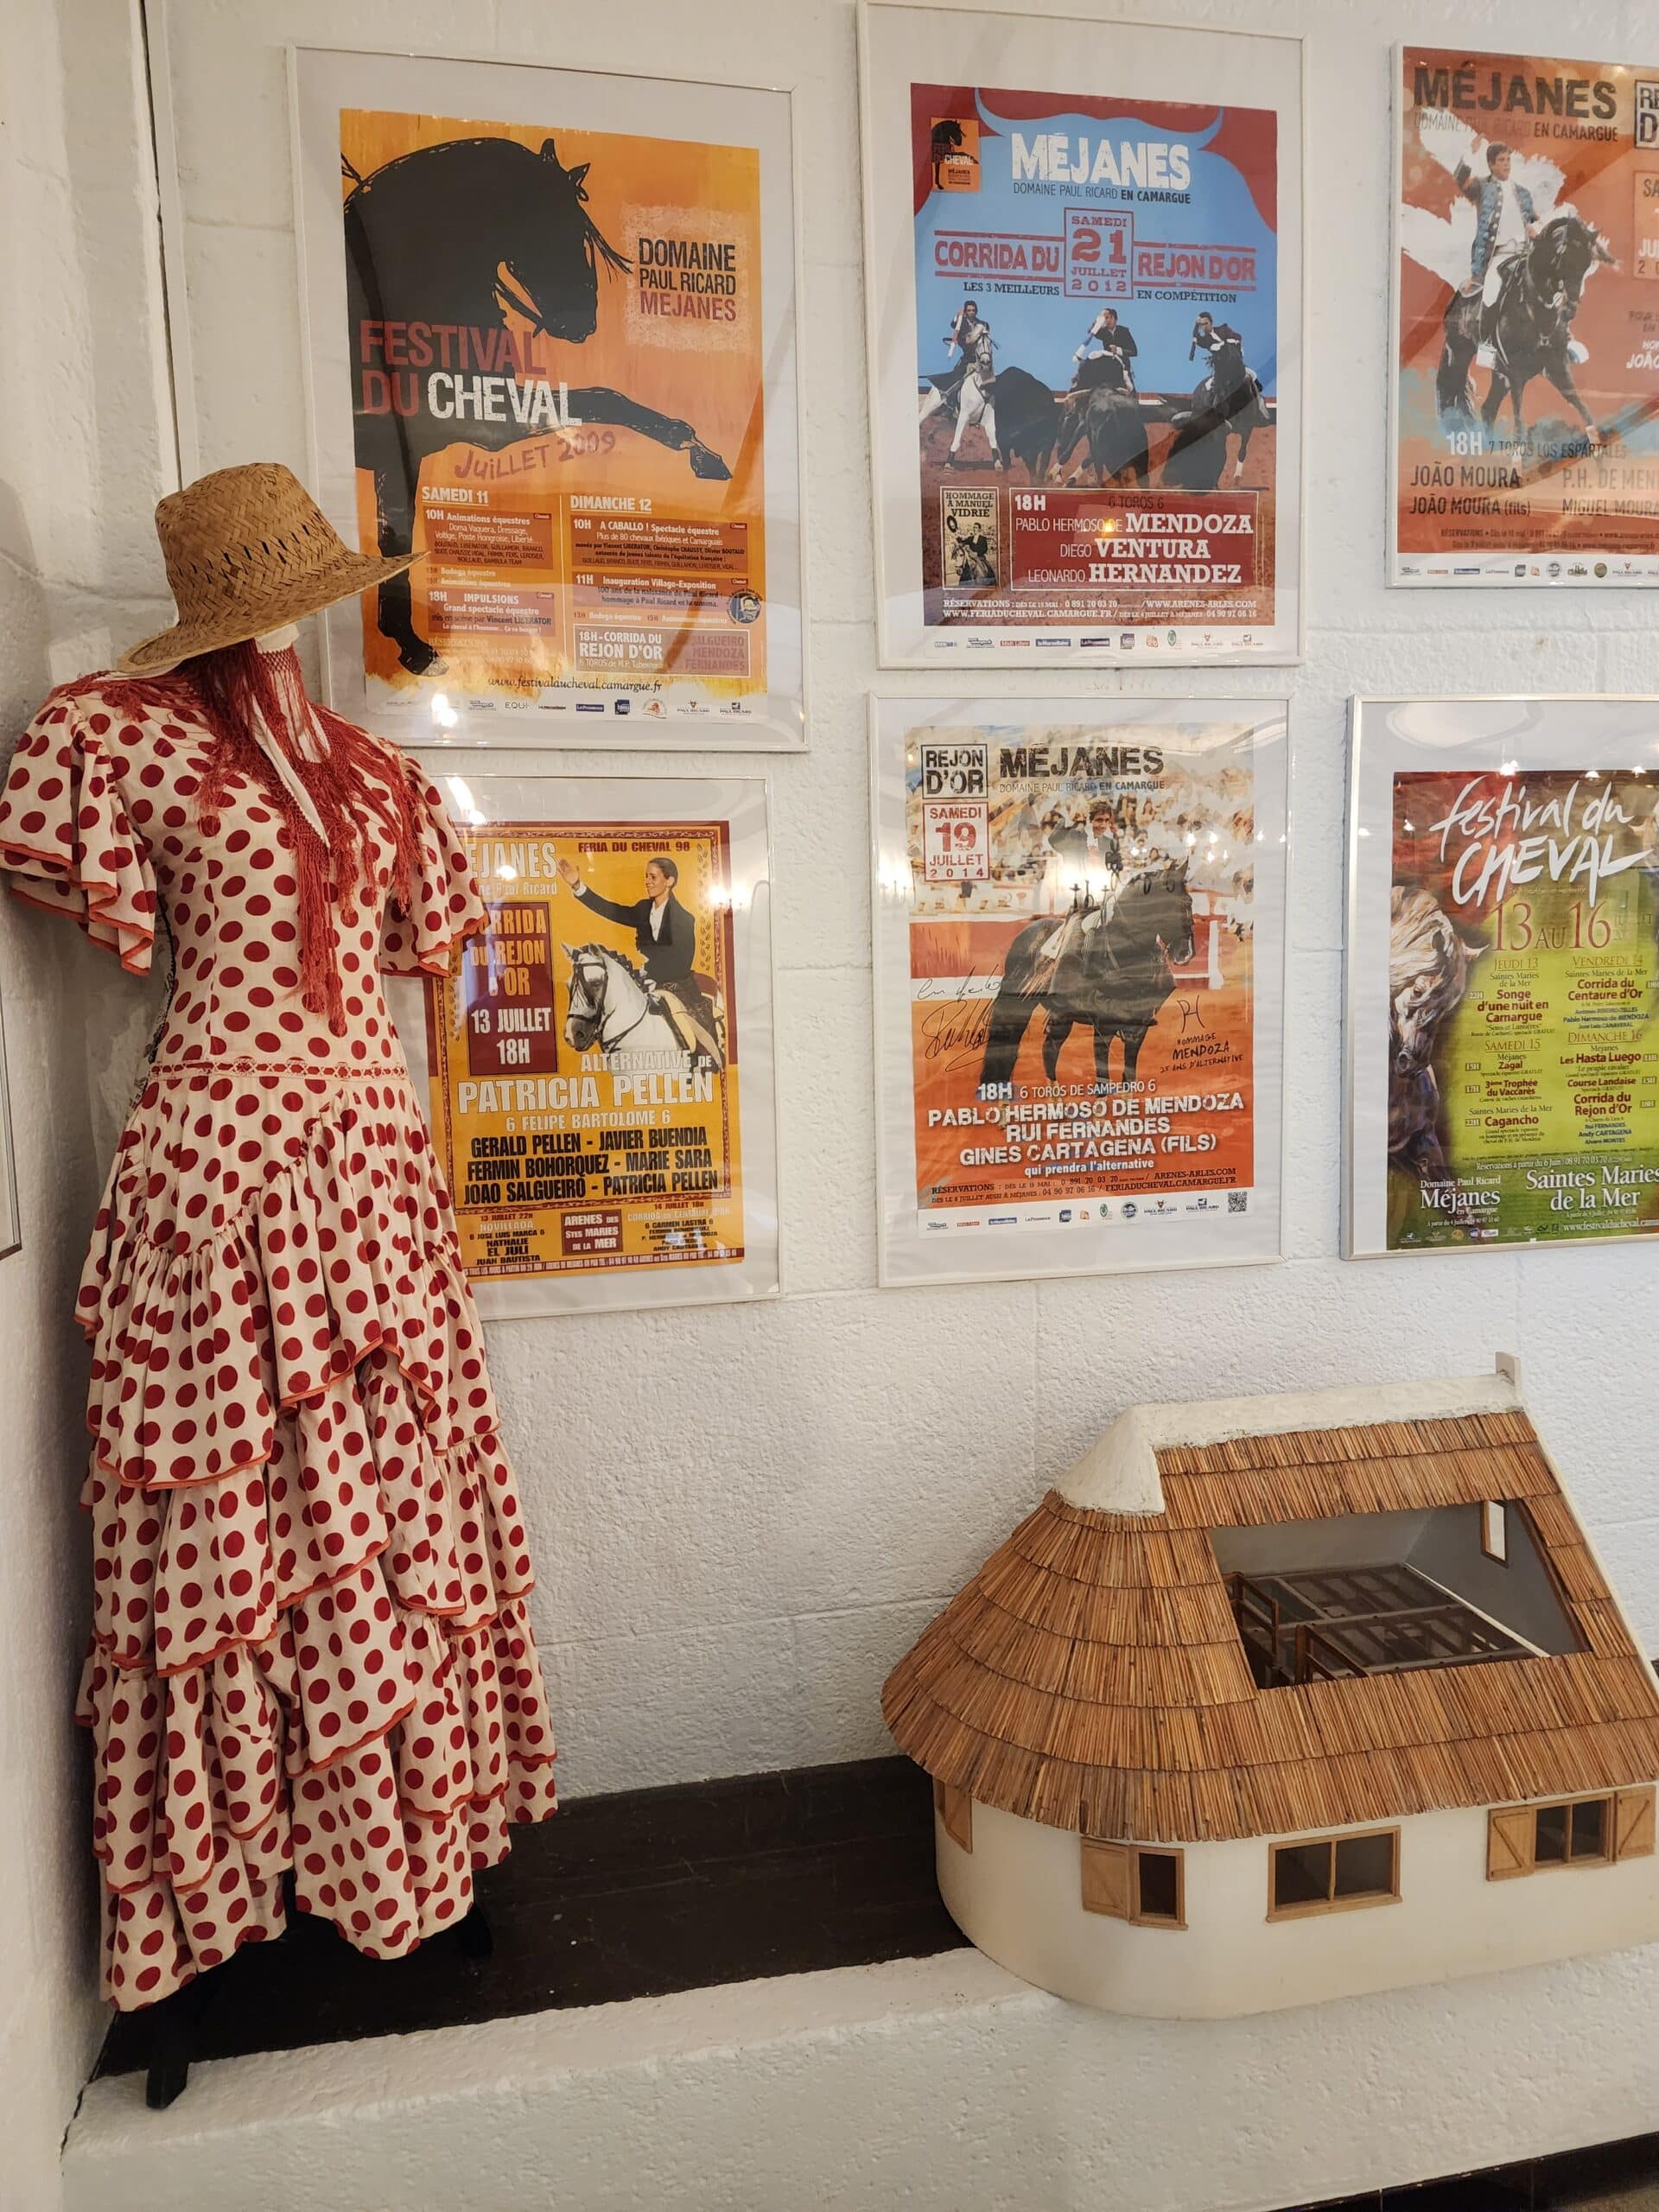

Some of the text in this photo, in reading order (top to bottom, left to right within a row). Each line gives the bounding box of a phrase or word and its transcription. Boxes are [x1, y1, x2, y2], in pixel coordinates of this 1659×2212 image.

[944, 154, 973, 165] CHEVAL
[1011, 131, 1191, 191] MÉJANES
[1014, 182, 1191, 204] DOMAINE PAUL RICARD EN CAMARGUE
[1071, 216, 1127, 227] SAMEDI
[639, 238, 735, 272] DOMAINE
[935, 240, 1059, 271] CORRIDA DU
[1071, 227, 1127, 264] 21
[1071, 266, 1127, 277] JUILLET
[1138, 251, 1205, 278] REJON
[639, 268, 735, 296] PAUL RICARD
[963, 282, 1059, 296] LES 3 MEILLEURS
[639, 291, 736, 321] MEJANES
[1138, 289, 1236, 303] EN COMPÉTITION
[359, 320, 546, 375] FESTIVAL
[362, 369, 582, 427] DU CHEVAL
[558, 430, 616, 461] 2009
[1446, 431, 1483, 456] 18H
[1410, 461, 1521, 488] JOÃO MOURA
[422, 486, 488, 504] SAMEDI 11
[570, 495, 652, 512] DIMANCHE 12
[945, 492, 995, 501] HOMMAGE
[1014, 494, 1046, 512] 18H
[1410, 493, 1531, 517] JOÃO MOURA (fils)
[574, 519, 591, 530] 10H
[608, 522, 644, 531] CABALLO
[652, 524, 685, 534] Spectacle
[688, 527, 720, 536] équestre
[1016, 518, 1050, 531] PABLO
[1053, 518, 1104, 532] HERMOSO
[1126, 513, 1253, 534] MENDOZA
[1060, 538, 1211, 559] DIEGO VENTURA
[576, 575, 716, 590] 11H Inauguration Village-Exposition
[1028, 563, 1242, 584] LEONARDO HERNANDEZ
[925, 750, 983, 767] REJON
[926, 769, 983, 794] D'OR
[999, 780, 1165, 793] DOMAINE PAUL RICARD EN CAMARGUE
[930, 807, 982, 819] SAMEDI
[1582, 781, 1635, 835] du
[578, 842, 690, 853] FERIA DU CHEVAL 98
[935, 822, 977, 852] 19
[929, 855, 983, 866] JUILLET
[1452, 835, 1654, 907] CHEVAL
[1493, 900, 1611, 952] 13 AU 16
[1578, 978, 1635, 989] Corrida du
[1497, 989, 1531, 1001] Songe
[1568, 990, 1618, 1001] Centaure
[471, 1007, 551, 1034] 13 JUILLET
[1486, 1013, 1542, 1024] Camargue
[497, 1038, 531, 1065] 18H
[581, 1050, 712, 1072] ALTERNATIVE DE
[1172, 1042, 1230, 1060] MENDOZA
[458, 1071, 712, 1114] PATRICIA PELLEN
[977, 1079, 1156, 1101] 18H 6 TOROS DE SAMPEDRO 6
[1573, 1092, 1631, 1104] Corrida du
[928, 1092, 1243, 1127] PABLO HERMOSO DE MENDOZA
[1575, 1105, 1606, 1116] Rejon
[506, 1110, 671, 1132] 6 FELIPE BARTOLOME 6
[1006, 1117, 1171, 1143] RUI FERNANDES
[1485, 1116, 1539, 1128] Cagancho
[471, 1126, 707, 1158] GERALD PELLEN JAVIER BUENDIA
[960, 1133, 1216, 1166] GINES CARTAGENA (FILS)
[467, 1148, 712, 1181] FERMIN BOHORQUEZ MARIE SARA
[1025, 1166, 1042, 1179] qui
[1046, 1162, 1087, 1177] prendra
[464, 1170, 718, 1205] JOAO SALGUEIRO PATRICIA PELLEN
[1421, 1175, 1500, 1189] Domaine Paul Ricard
[1526, 1170, 1595, 1190] Saintes
[1421, 1189, 1500, 1214] Méjanes
[1550, 1188, 1641, 1211] de la Mer
[564, 1215, 603, 1226] ARENES
[586, 1226, 619, 1238] MARIES
[594, 1239, 616, 1249] MER
